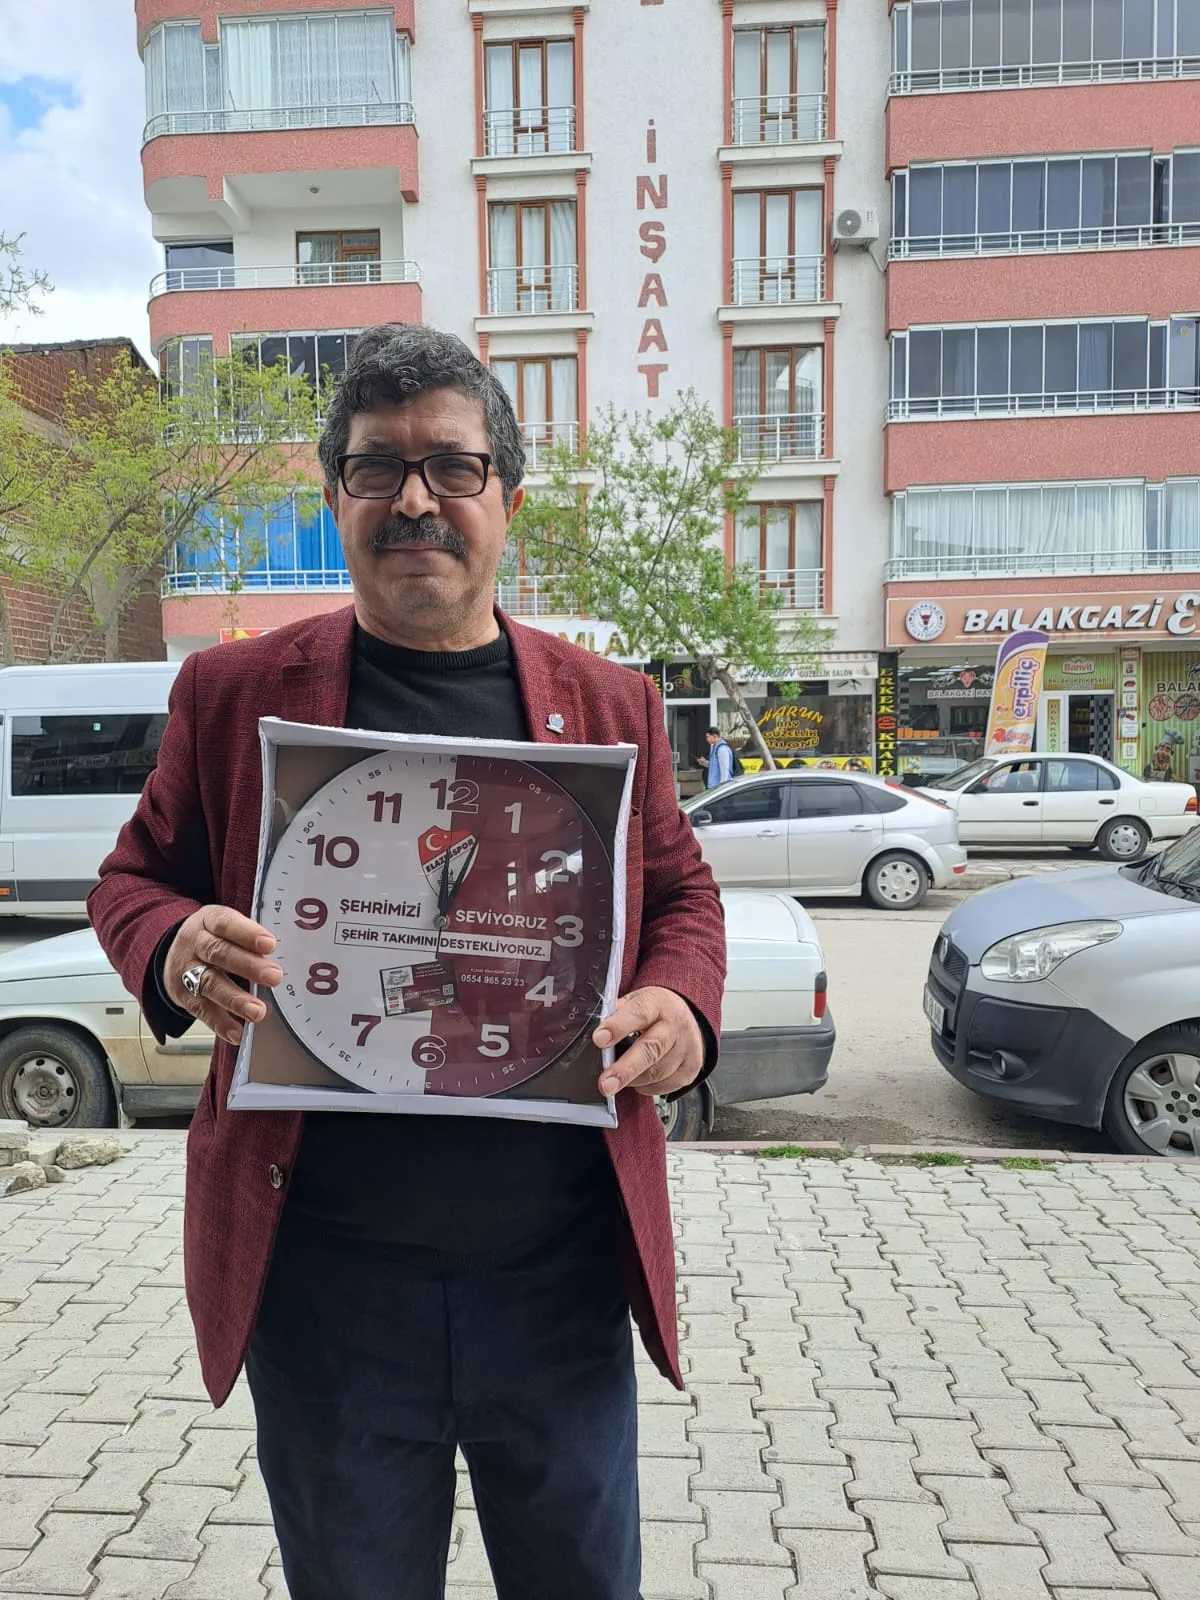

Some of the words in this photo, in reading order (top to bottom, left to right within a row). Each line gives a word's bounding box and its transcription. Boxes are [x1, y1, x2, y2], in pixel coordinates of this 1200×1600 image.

[636, 118, 669, 398] İNŞAAT
[963, 597, 1164, 632] BALAKGAZİ
[1064, 663, 1093, 672] Banvit
[879, 667, 894, 714] ERKEK
[1014, 660, 1038, 717] erpiliç
[1157, 682, 1200, 693] BALA
[757, 705, 823, 727] HARUN
[368, 769, 382, 779] 55
[528, 783, 542, 795] 05
[367, 791, 403, 824] 11
[429, 778, 480, 814] 12
[302, 820, 315, 834] 50
[504, 802, 522, 834] 1
[307, 833, 360, 868] 10
[425, 838, 475, 873] ELAZSPOR
[539, 850, 570, 883] 2
[274, 900, 282, 913] 45
[294, 897, 328, 931] 9
[339, 898, 422, 918] ŞEHRİMİZİ
[455, 909, 548, 930] SEVİYORUZ
[341, 928, 379, 942] ŞEHİR
[381, 932, 438, 947] TAKIMINI
[440, 936, 546, 957] DESTEKLİYORUZ.
[552, 914, 584, 947] 3
[286, 984, 296, 997] 40
[306, 962, 339, 996] 8
[461, 974, 481, 983] 0554
[524, 975, 558, 1008] 4
[350, 1013, 382, 1047] 7
[477, 1023, 510, 1058] 5
[411, 1033, 448, 1071] 6
